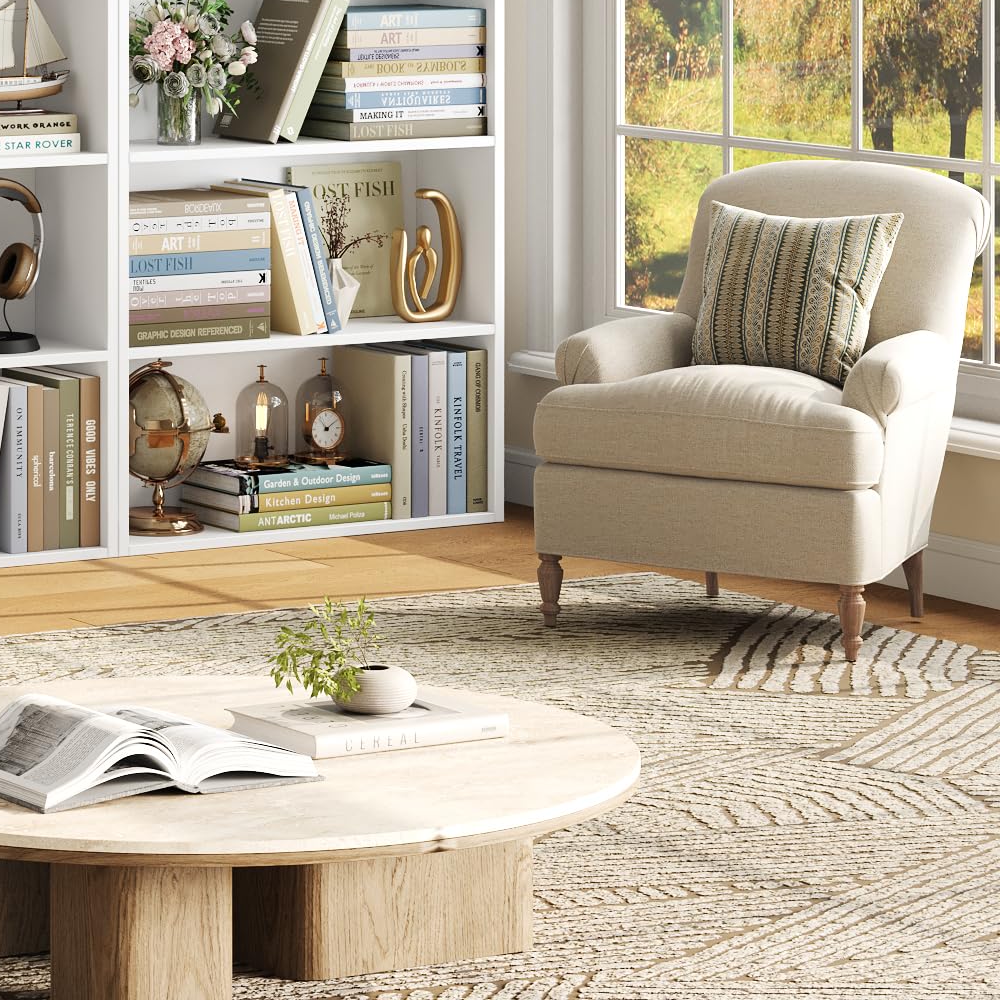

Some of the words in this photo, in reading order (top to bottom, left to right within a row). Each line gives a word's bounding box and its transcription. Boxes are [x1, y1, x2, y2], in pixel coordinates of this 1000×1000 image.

[380, 14, 402, 27] ART
[380, 32, 402, 44] ART
[32, 120, 72, 128] ORANGE
[360, 112, 393, 120] MAKING
[352, 125, 384, 138] LOST
[386, 124, 414, 136] FISH
[4, 141, 31, 150] STAR
[35, 140, 72, 149] ROVER
[313, 183, 350, 198] OST
[354, 180, 396, 198] FISH
[162, 236, 184, 251] ART
[130, 258, 162, 274] LOST
[166, 256, 193, 272] FISH
[137, 330, 169, 340] GRAPHIC
[170, 328, 196, 338] DESIGN
[198, 325, 242, 336] REFERENCED
[16, 408, 22, 424] ON
[454, 396, 462, 442] KINFOLK
[66, 414, 74, 450] TERENCE
[85, 419, 96, 443] GOOD
[434, 408, 442, 452] KINFOLK
[66, 450, 74, 485] CONRAN'S
[85, 449, 96, 476] VIBES
[454, 444, 462, 480] TRAVEL
[32, 454, 41, 488] spherical
[264, 478, 291, 489] Garden
[294, 478, 299, 486] &
[302, 476, 333, 486] Outdoor
[336, 473, 360, 483] Design
[85, 480, 96, 502] ONLY
[265, 496, 300, 508] Kitchen
[304, 494, 336, 504] Design
[258, 514, 312, 527] ANTARCTIC
[345, 732, 420, 752] CEREAL
